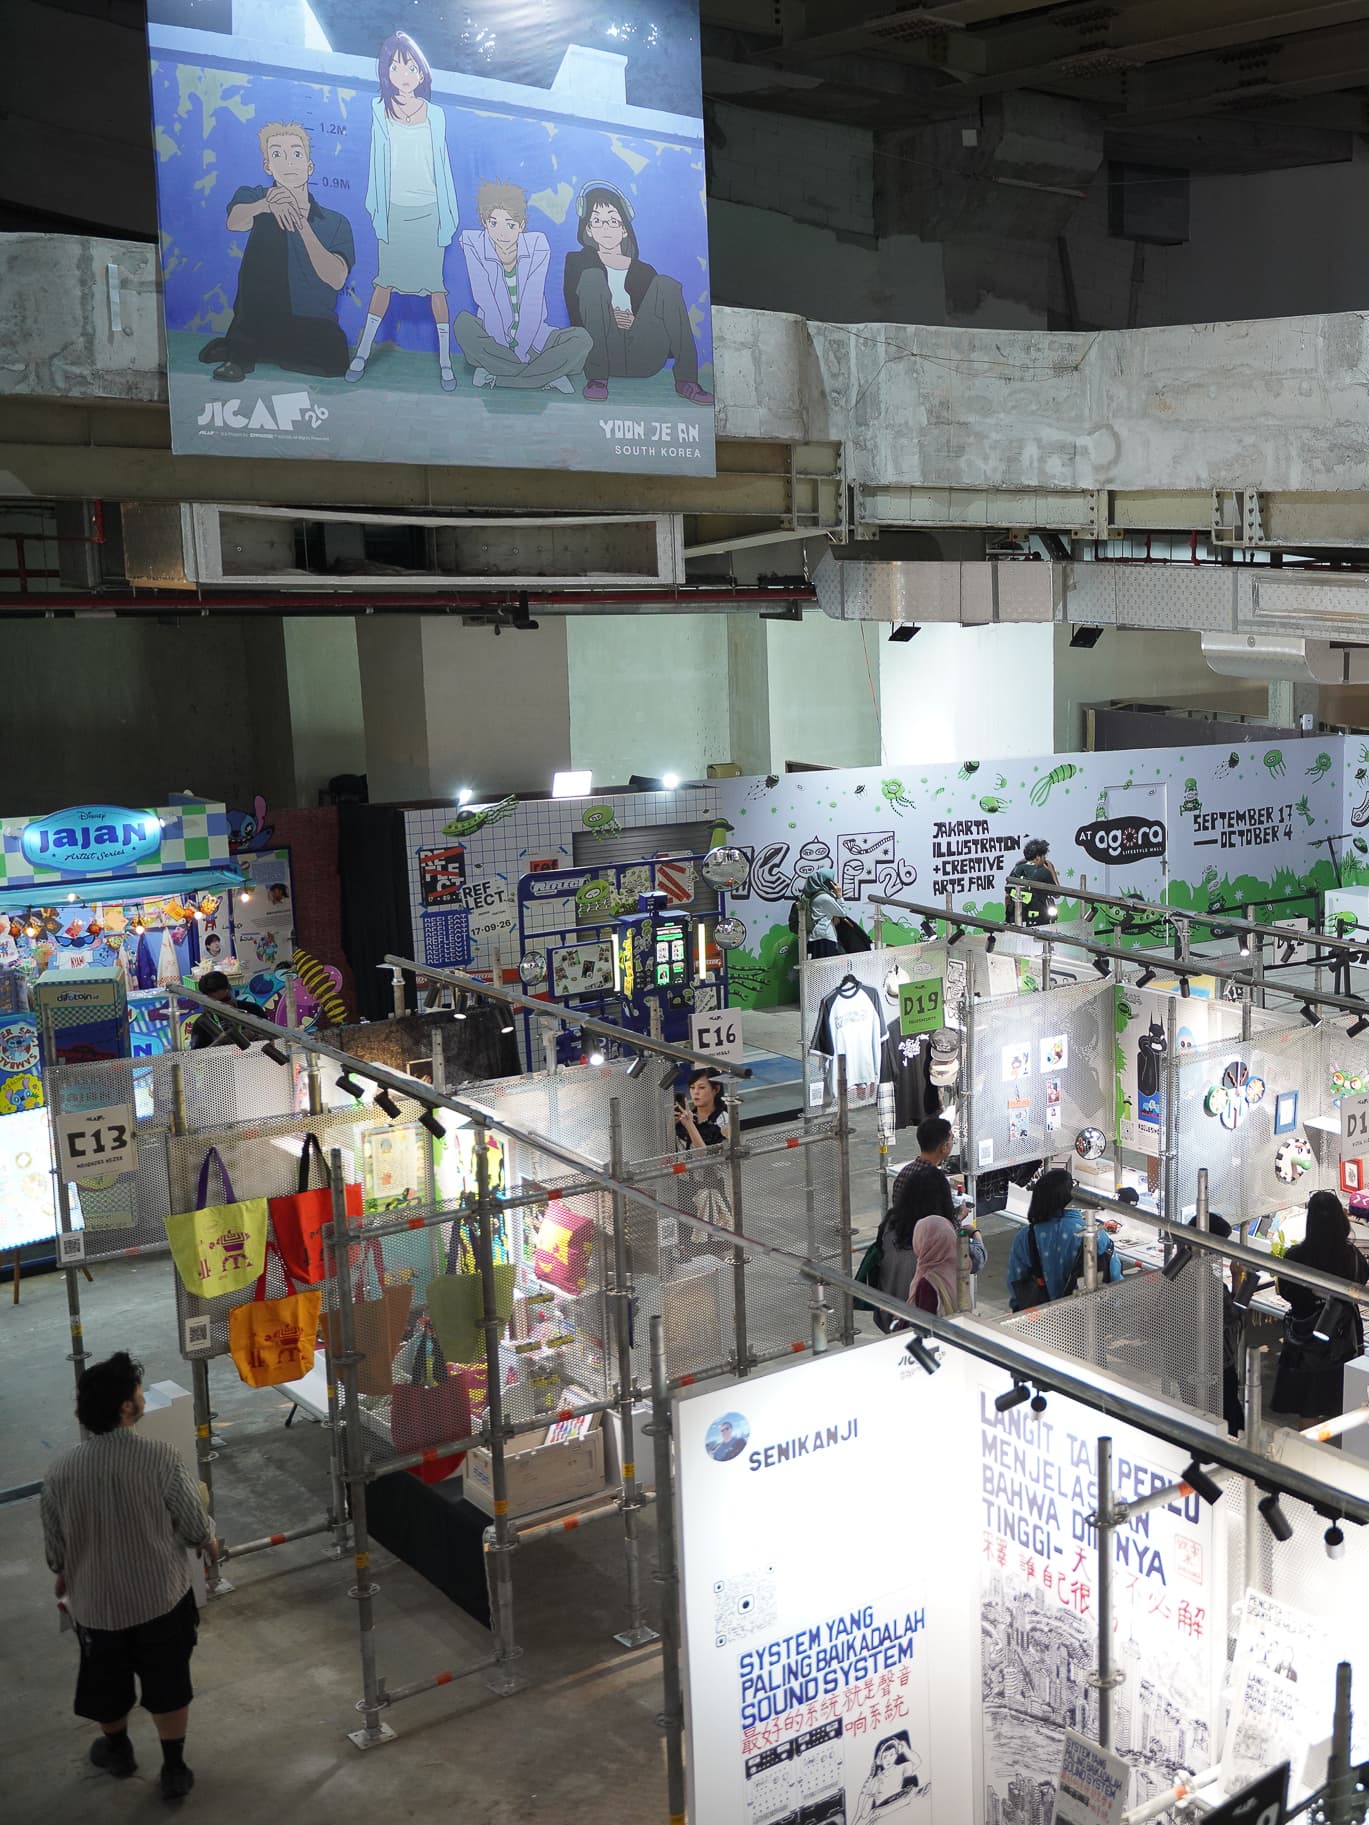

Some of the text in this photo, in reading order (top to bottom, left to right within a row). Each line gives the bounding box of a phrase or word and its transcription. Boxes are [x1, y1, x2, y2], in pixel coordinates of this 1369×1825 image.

[322, 177, 350, 189] 0.9M
[600, 419, 699, 443] YOON JE AN
[615, 445, 701, 458] SOUTH KOREA
[933, 819, 989, 839] JAKARTA
[1193, 804, 1293, 832] SEPTEMBER 17
[932, 834, 1021, 859] ILLUSTRATION
[1079, 825, 1163, 857] AT agora
[1220, 824, 1293, 848] OCTOBER 4
[64, 849, 125, 861] Artist Series
[932, 855, 1004, 876] +CREATIVE
[462, 881, 491, 899] REF
[933, 873, 995, 896] ARTS FAIR
[904, 991, 939, 1016] D19
[698, 1023, 736, 1049] C16
[67, 1124, 128, 1158] C13
[980, 1391, 1053, 1453] LANGIT
[982, 1463, 1060, 1531] BAHWA
[740, 1605, 874, 1678] SYSTEM YANG
[741, 1637, 913, 1730] SOUND SYSTEM
[742, 1654, 812, 1704] PALING
